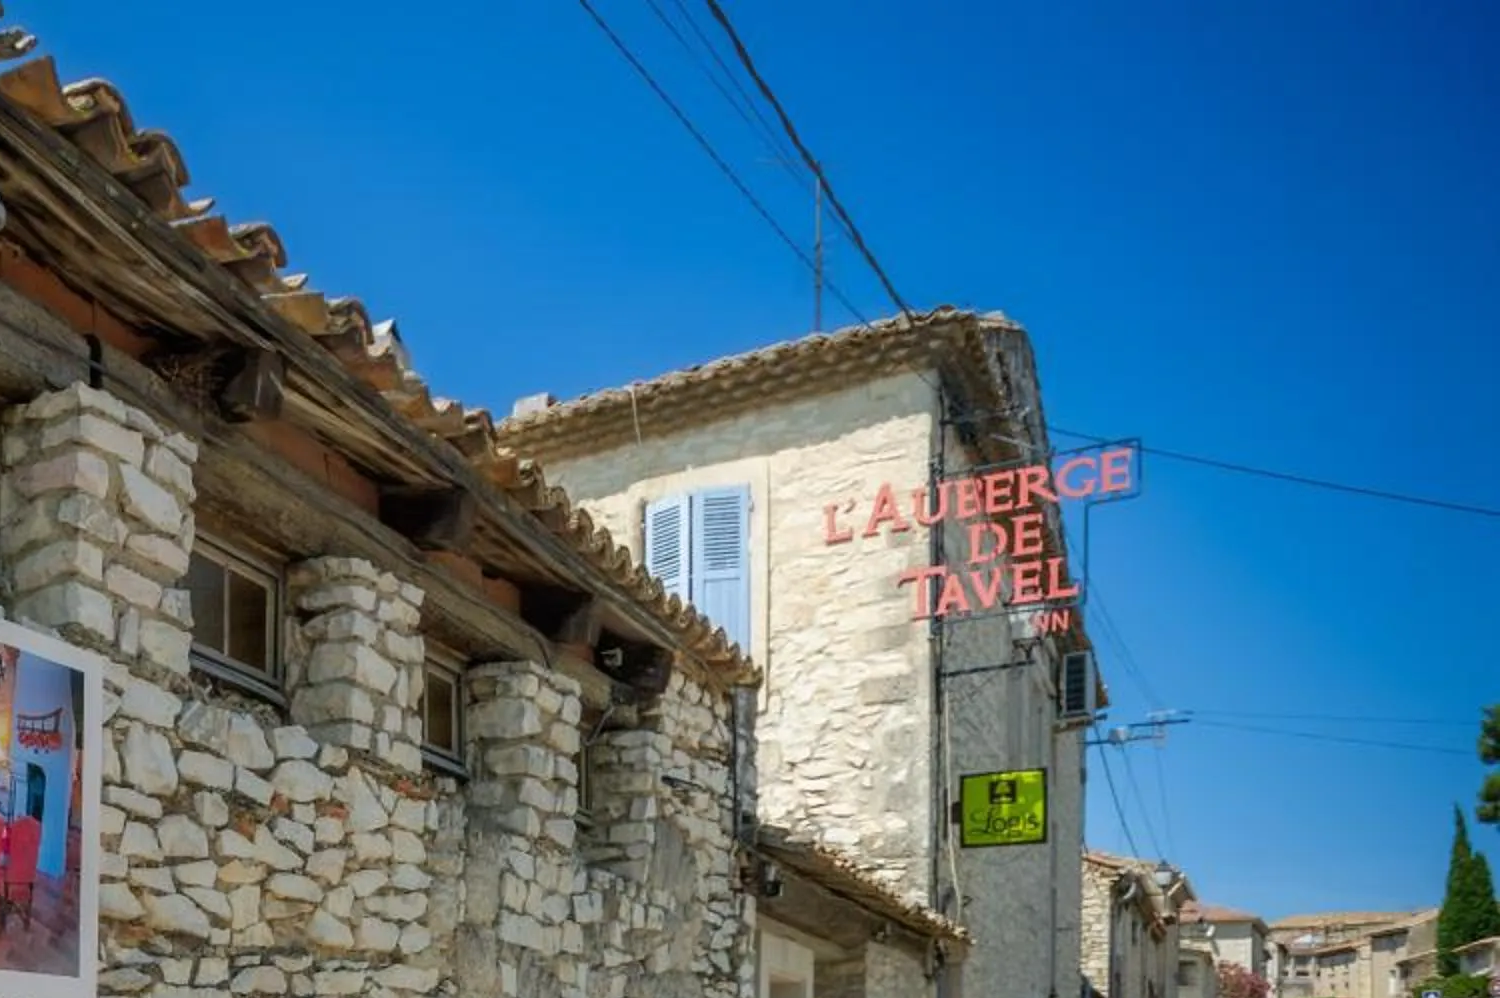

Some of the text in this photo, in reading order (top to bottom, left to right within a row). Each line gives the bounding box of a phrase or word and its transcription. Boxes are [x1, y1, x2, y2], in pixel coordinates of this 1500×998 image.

[821, 446, 1134, 546] L'AUBERGE
[965, 512, 1045, 565] DE
[896, 555, 1081, 621] TAVEL
[969, 806, 1041, 838] Logis
